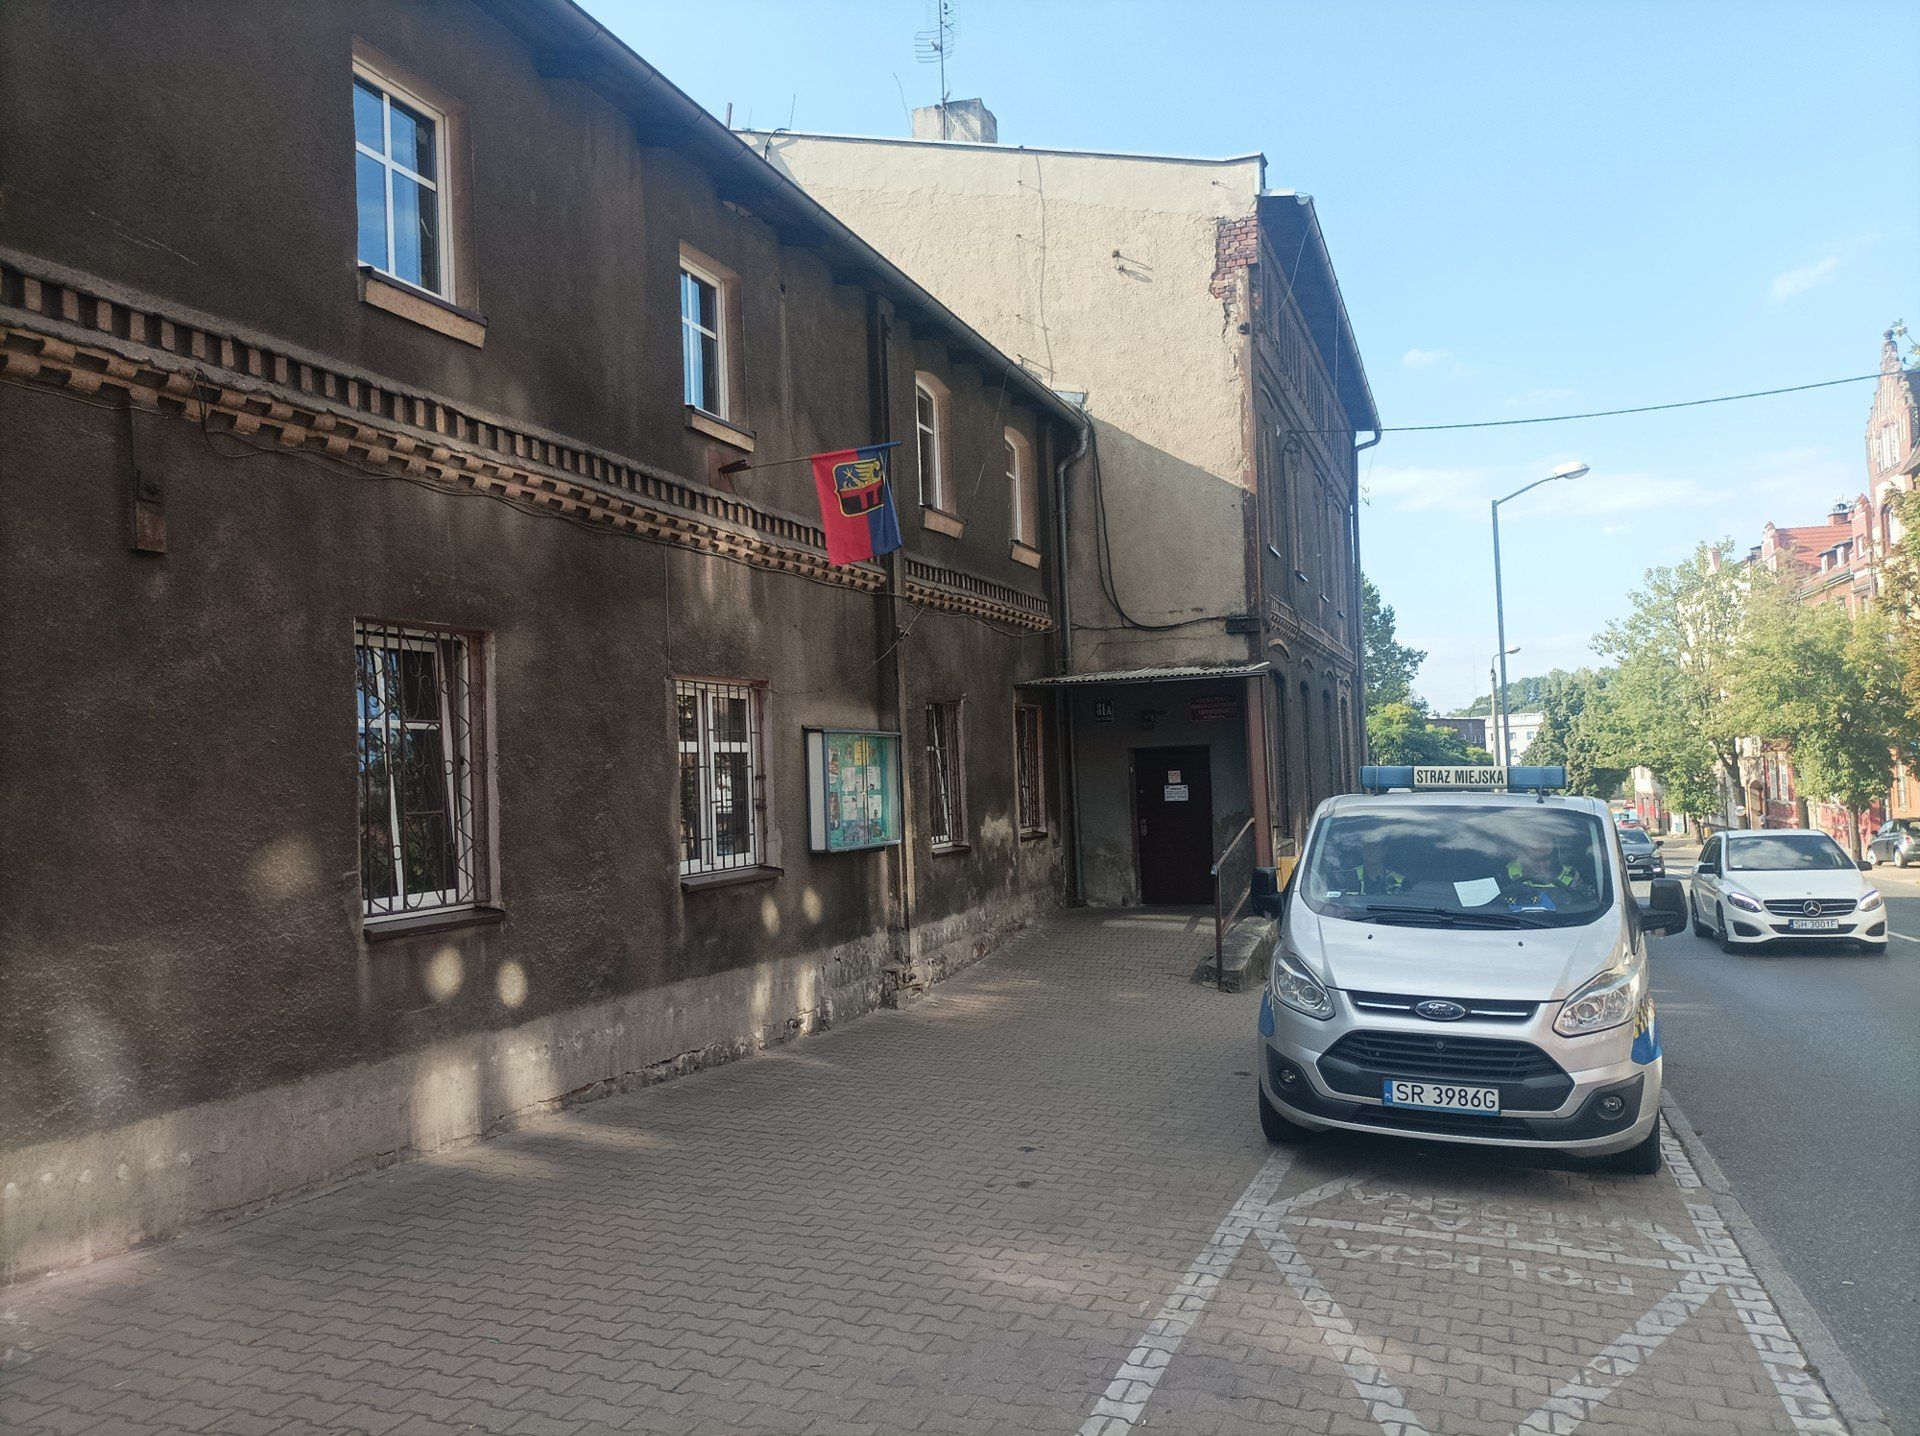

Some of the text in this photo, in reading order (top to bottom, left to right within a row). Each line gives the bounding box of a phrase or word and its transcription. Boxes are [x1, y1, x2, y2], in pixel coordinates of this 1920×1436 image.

[1454, 769, 1505, 785] MIEJSKA
[1396, 1083, 1496, 1109] SR 3986G
[1334, 1238, 1634, 1296] POLICJA
